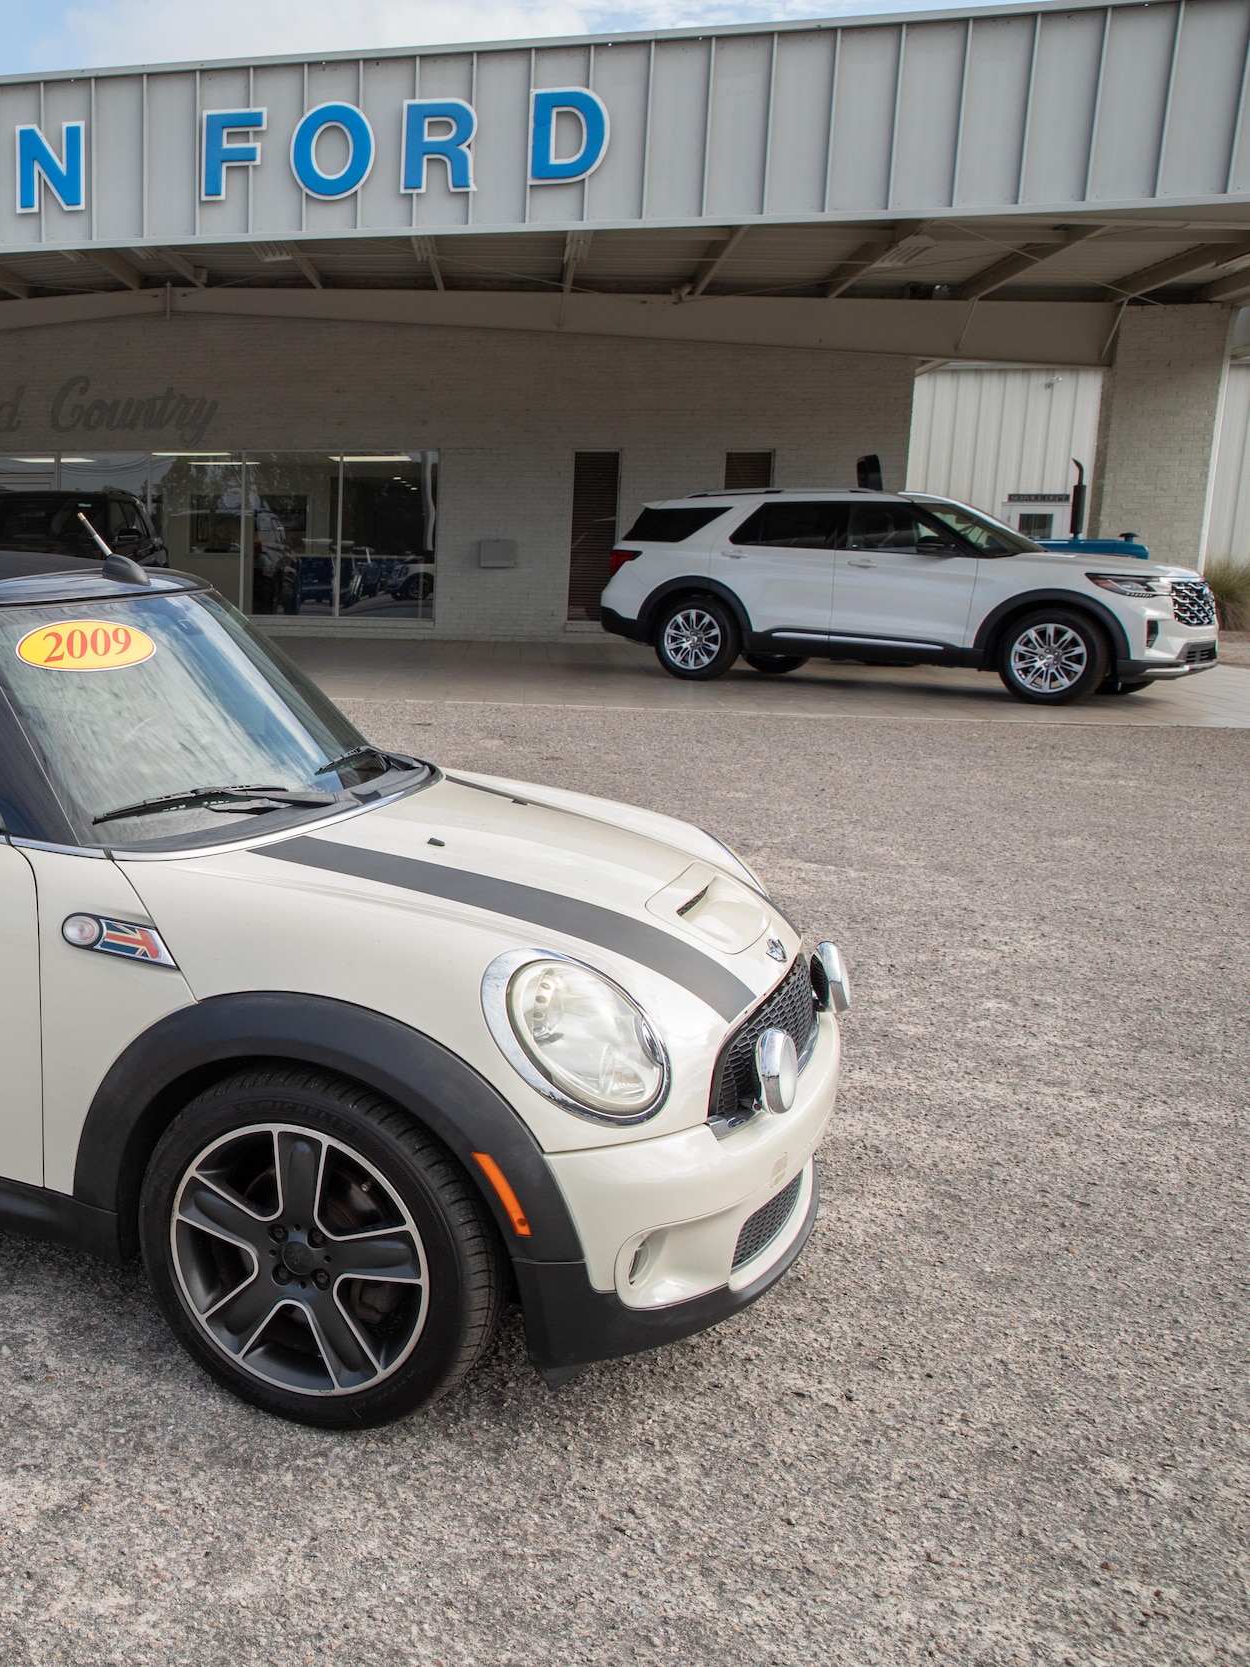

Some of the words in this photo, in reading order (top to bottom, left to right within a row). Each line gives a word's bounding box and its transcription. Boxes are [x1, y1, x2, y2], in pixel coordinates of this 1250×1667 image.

[201, 86, 610, 200] FORD
[51, 375, 219, 448] Country
[43, 627, 132, 663] 2009
